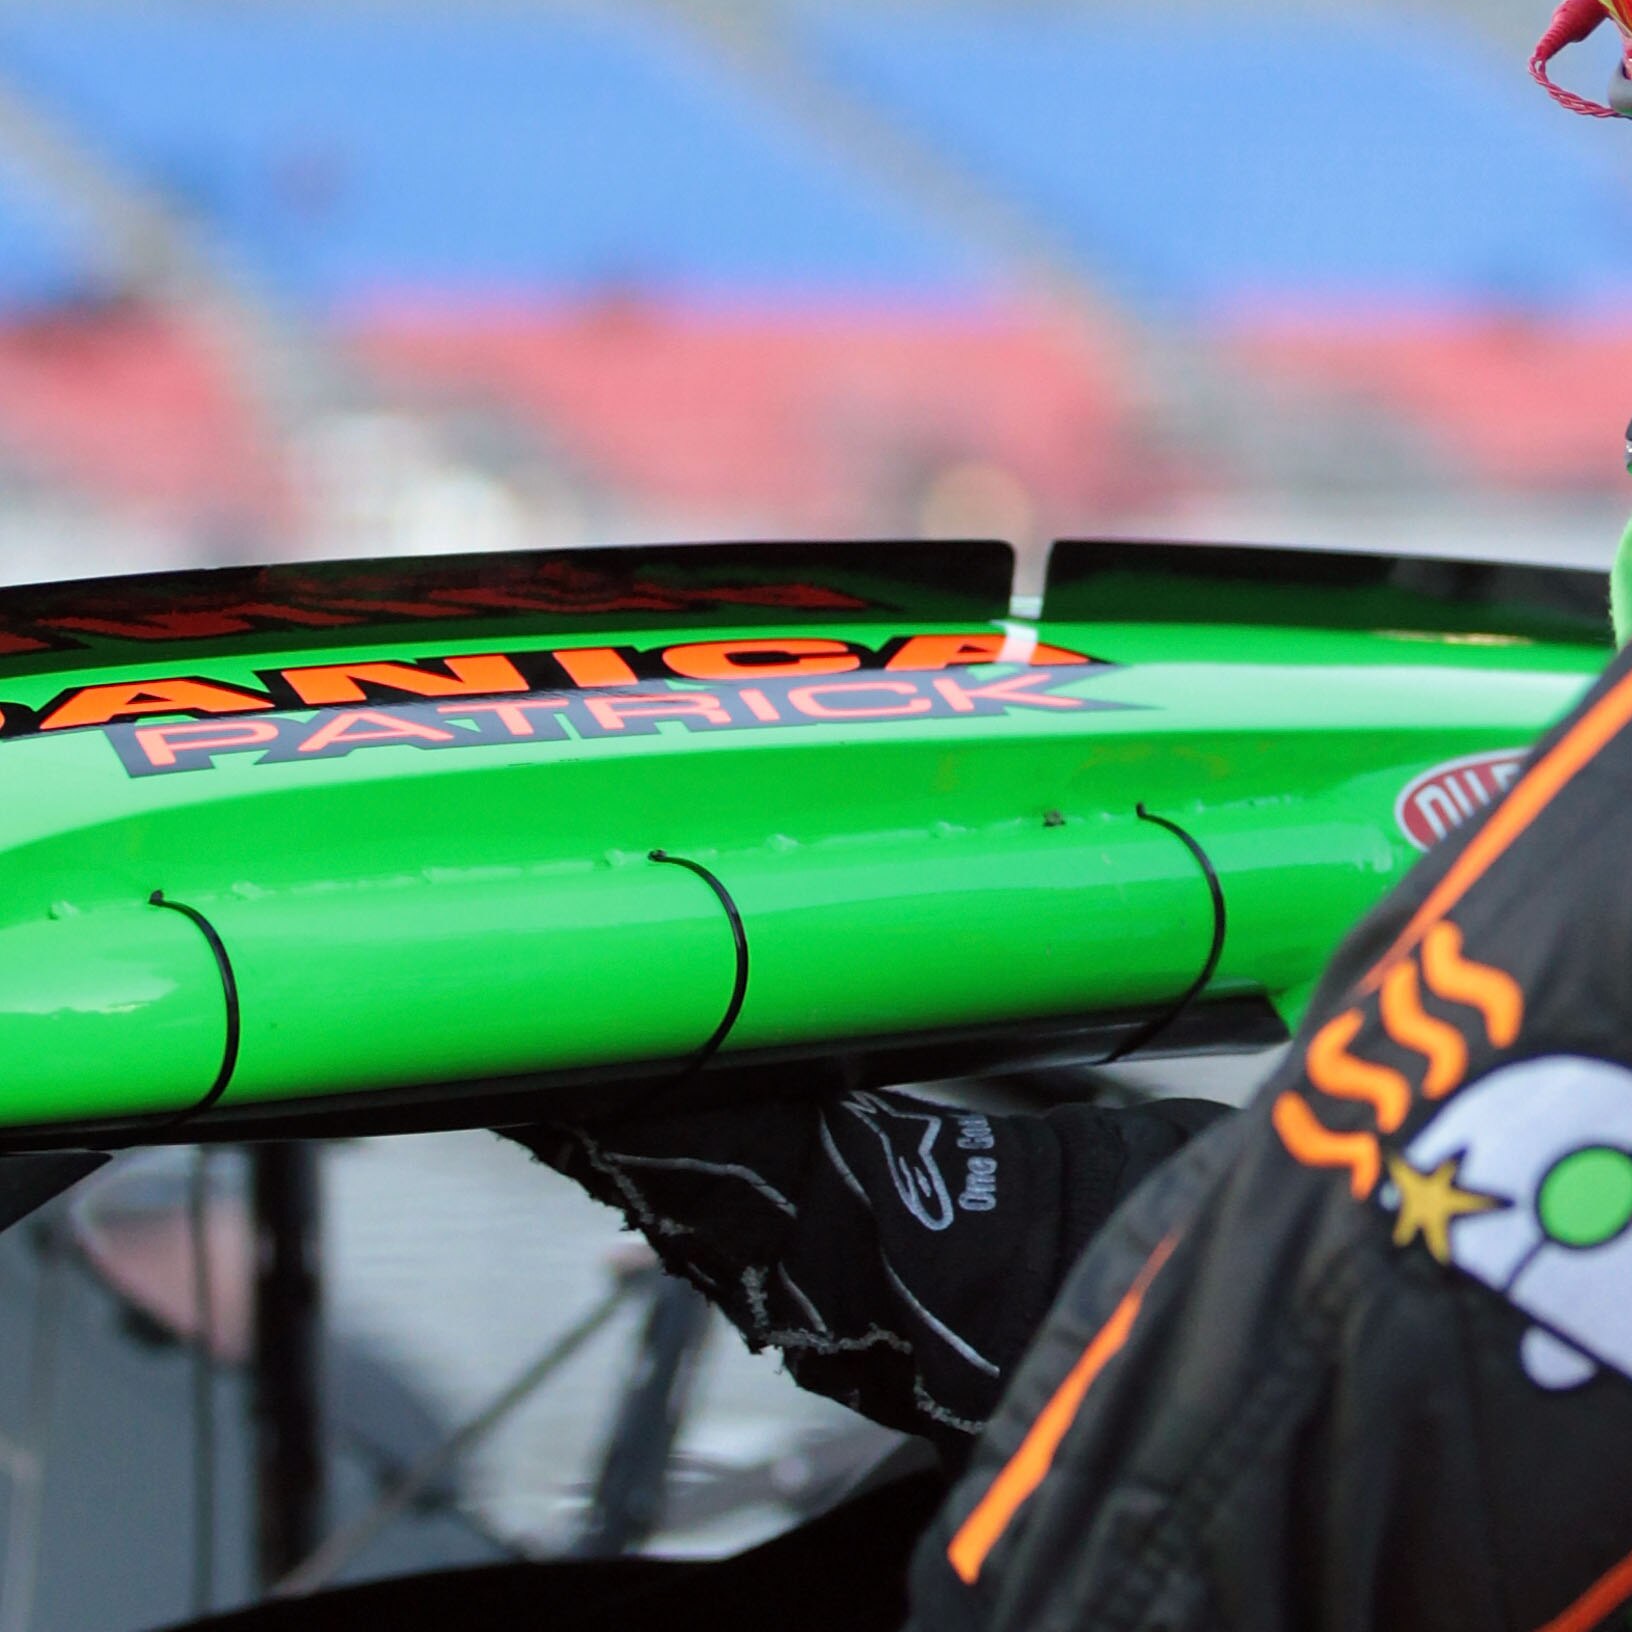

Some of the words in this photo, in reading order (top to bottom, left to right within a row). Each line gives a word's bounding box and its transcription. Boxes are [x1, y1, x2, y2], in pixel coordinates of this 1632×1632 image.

[0, 633, 1096, 732] ANICA
[133, 672, 1096, 767] PATRICK
[956, 1114, 996, 1150] Goa
[957, 1155, 998, 1212] One
